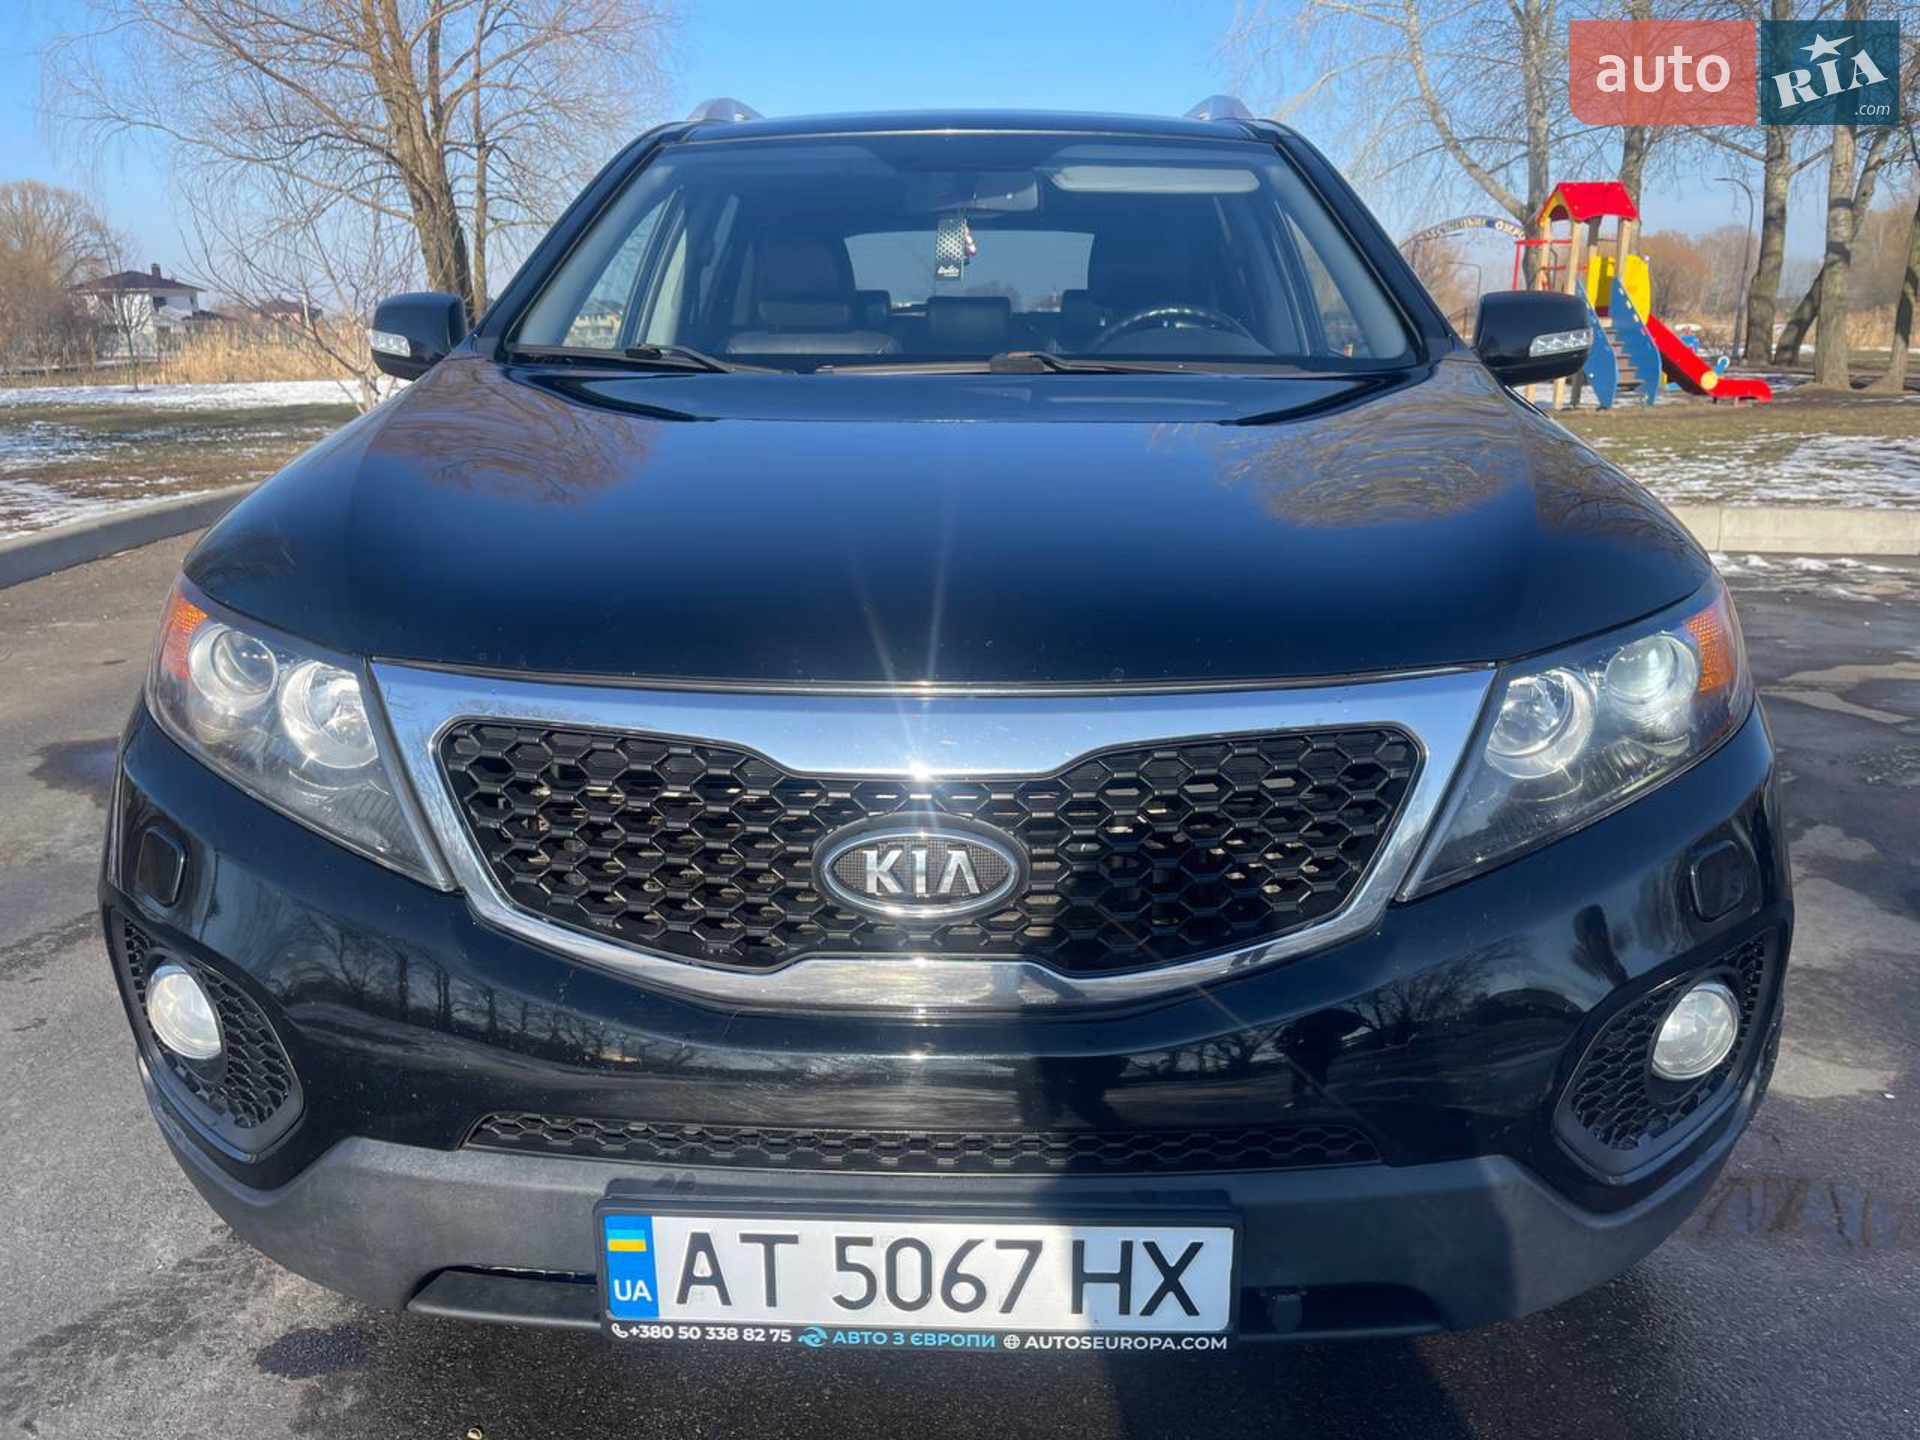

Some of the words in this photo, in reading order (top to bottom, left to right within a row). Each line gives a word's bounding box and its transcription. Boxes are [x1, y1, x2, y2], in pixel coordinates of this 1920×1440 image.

[862, 849, 981, 895] KIA
[676, 1231, 799, 1308] AT
[832, 1236, 1043, 1314] 5067
[1071, 1240, 1204, 1316] HX
[614, 1279, 652, 1302] UA
[629, 1325, 674, 1340] +380
[677, 1326, 701, 1340] 50
[705, 1326, 739, 1341] 338
[742, 1328, 766, 1342] 82
[769, 1328, 792, 1343] 75
[832, 1331, 888, 1345] АВТО
[910, 1332, 996, 1348] ЄВРОПИ
[1024, 1335, 1227, 1350] AUTOSEUROPA.COM
